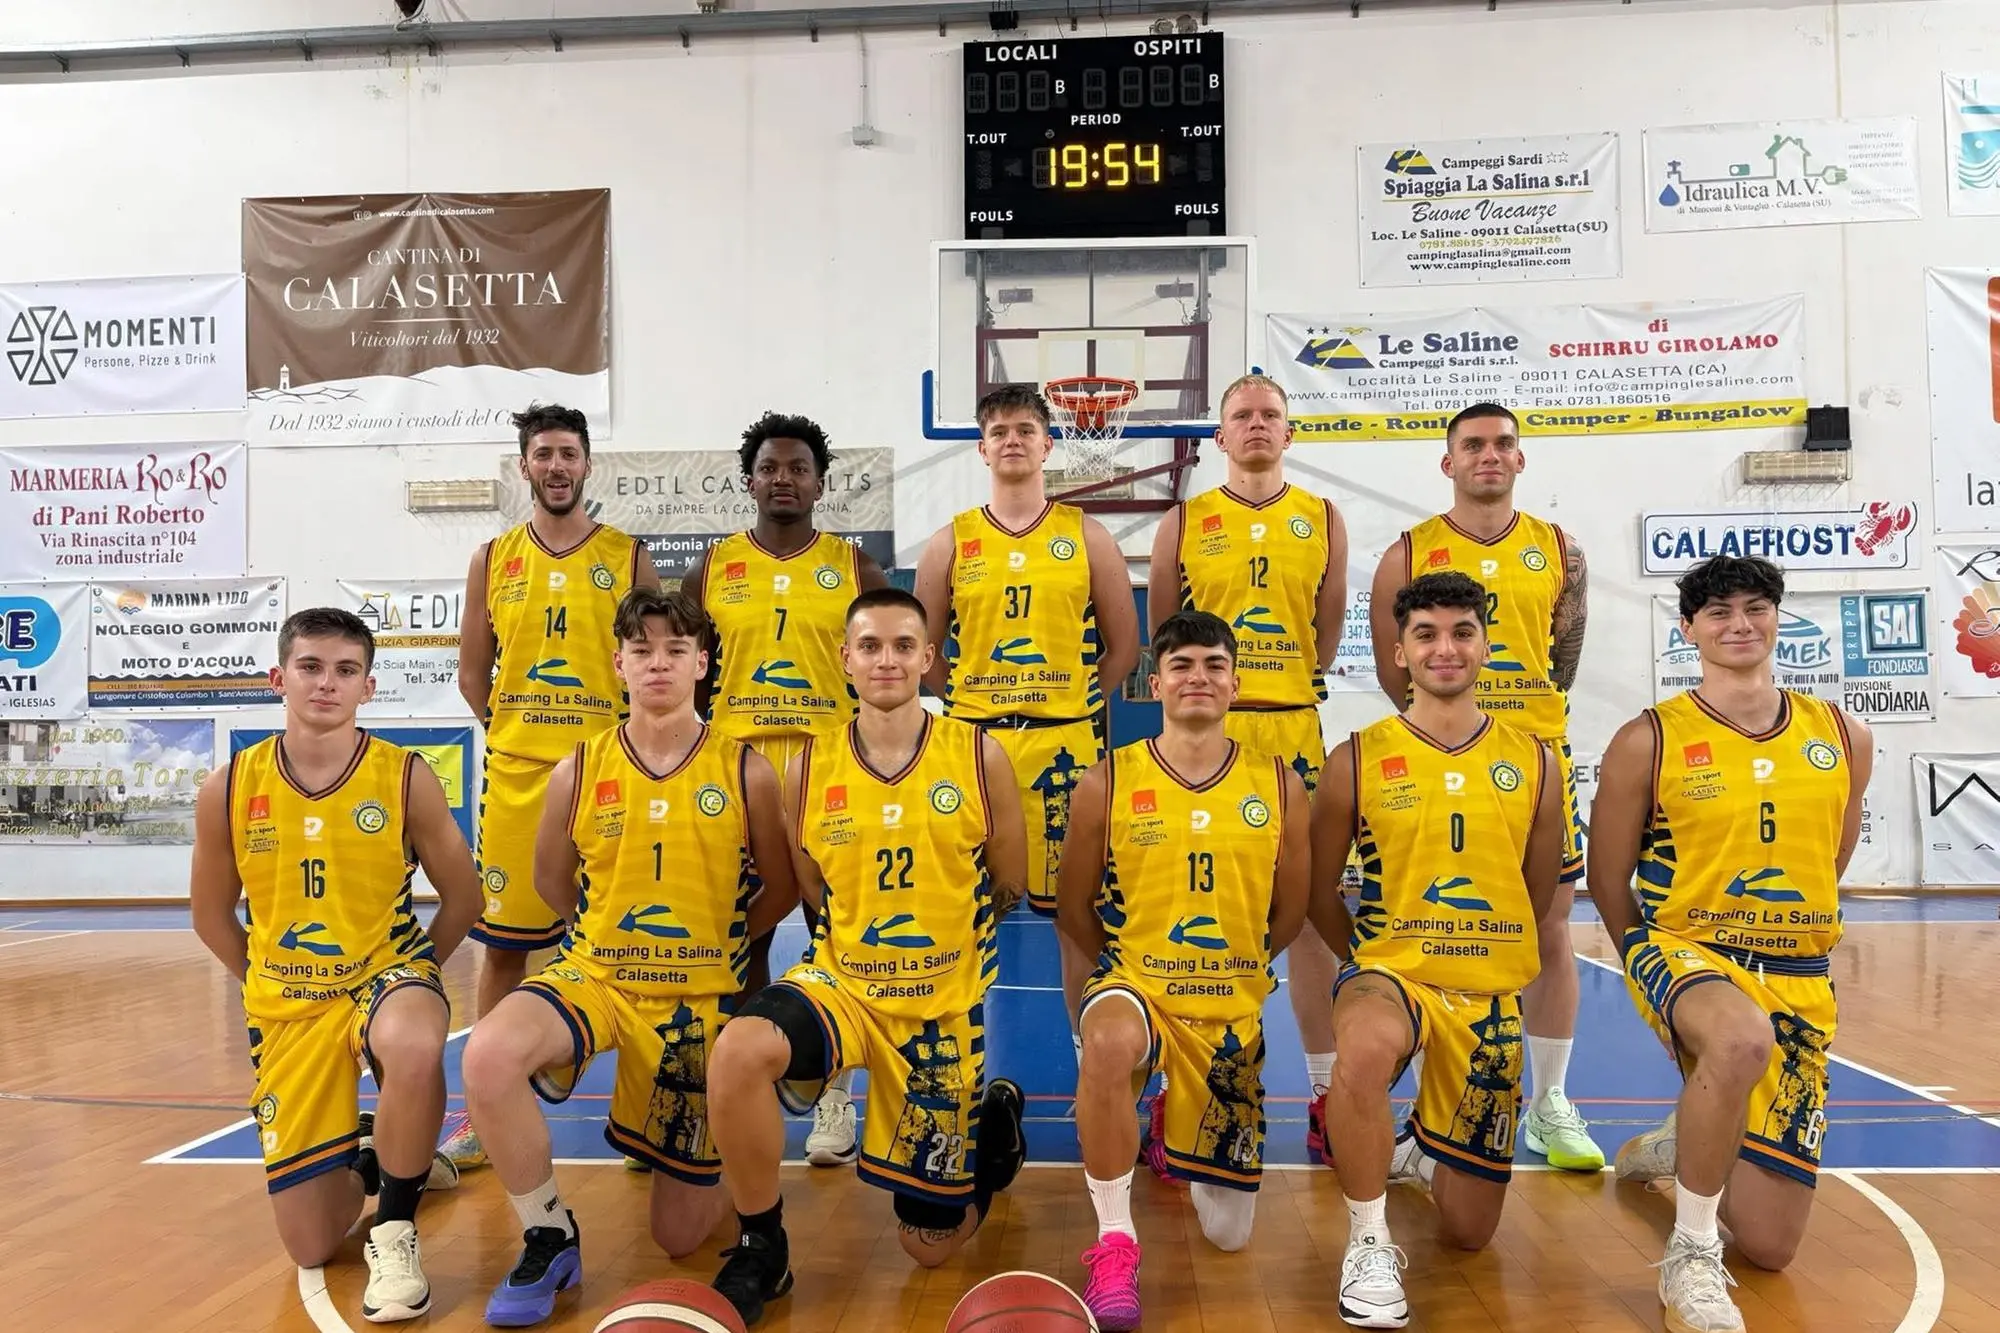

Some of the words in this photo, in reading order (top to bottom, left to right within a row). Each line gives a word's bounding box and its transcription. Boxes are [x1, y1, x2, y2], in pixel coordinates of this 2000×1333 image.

[986, 44, 1057, 62] LOCALI
[1134, 38, 1202, 56] OSPITI
[1055, 80, 1066, 94] B
[1209, 74, 1220, 88] B
[1070, 114, 1121, 126] PERIOD
[967, 134, 1007, 144] T.OUT
[1180, 126, 1222, 137] T.OUT
[1049, 143, 1160, 187] 19:54
[1442, 156, 1504, 170] Campeggi
[1508, 154, 1543, 166] Sardi
[1384, 178, 1462, 198] Spiaggia
[1466, 176, 1488, 192] La
[1492, 173, 1550, 191] Salina
[1685, 181, 1770, 202] Idraulica
[1776, 178, 1823, 197] M.V.
[970, 210, 1014, 222] FOULS
[1174, 204, 1220, 216] FOULS
[1412, 201, 1471, 223] Buone
[1474, 199, 1556, 224] Vacanze
[1372, 230, 1398, 242] Loc.
[1402, 230, 1417, 240] Le
[1420, 228, 1462, 240] Saline
[1471, 227, 1510, 238] 09011
[367, 248, 454, 266] CANTINA
[458, 247, 480, 264] DI
[283, 272, 568, 312] CALASETTA
[84, 316, 216, 348] MOMENTI
[1648, 319, 1669, 332] di
[350, 329, 430, 348] Viticoltori
[432, 328, 459, 346] dal
[466, 328, 500, 346] 1932
[1378, 334, 1413, 355] Le
[1423, 332, 1520, 354] Saline
[1548, 340, 1650, 358] SCHIRRU
[1657, 334, 1779, 354] GIROLAMO
[138, 354, 170, 367] Pizze
[174, 356, 181, 366] &
[185, 353, 217, 365] Drink
[1378, 358, 1444, 370] Campeggi
[1448, 356, 1486, 367] Sardi
[1489, 355, 1519, 366] s.r.l.
[1348, 372, 1416, 387] Località
[1424, 372, 1442, 384] Le
[1449, 370, 1502, 384] Saline
[1521, 370, 1568, 382] 09011
[1576, 365, 1682, 380] CALASETTA
[1689, 363, 1727, 377] (CA)
[1515, 382, 1568, 396] E-mail:
[1574, 374, 1794, 394] info@campinglesaline.com
[1402, 400, 1430, 411] Tel.
[1536, 397, 1562, 407] Fax
[269, 414, 302, 431] Dal
[308, 413, 343, 430] 1932
[346, 413, 392, 430] siamo
[407, 410, 462, 428] custodi
[466, 408, 492, 428] del
[1526, 412, 1631, 428] Camper
[1655, 404, 1795, 423] Bungalow
[10, 467, 129, 492] MARMERIA
[617, 476, 684, 496] EDIL
[32, 506, 52, 526] di
[61, 505, 108, 526] Pani
[116, 504, 205, 525] Roberto
[636, 505, 652, 516] DA
[713, 504, 728, 514] LA
[40, 532, 66, 548] Via
[72, 531, 146, 548] Rinascita
[1652, 524, 1856, 560] CALAFROST
[56, 552, 92, 566] zona
[98, 549, 184, 565] industriale
[1248, 556, 1269, 589] 12
[151, 590, 211, 608] MARINA
[217, 590, 250, 606] LIDO
[1004, 584, 1032, 619] 37
[95, 622, 184, 636] NOLEGGIO
[190, 621, 278, 634] GOMMONI
[545, 606, 568, 640] 14
[775, 608, 788, 641] 7
[1844, 600, 1858, 660] GRUPPO
[1872, 603, 1918, 645] SAI
[182, 641, 190, 650] E
[1257, 640, 1272, 650] La
[122, 658, 172, 670] MOTO
[178, 655, 256, 668] D'ACQUA
[408, 658, 435, 670] Main
[1868, 659, 1925, 674] FONDIARIA
[404, 672, 426, 684] Tel.
[964, 672, 1018, 686] Camping
[1020, 670, 1035, 682] La
[1496, 678, 1511, 689] La
[1818, 673, 1840, 684] AUTO
[1844, 680, 1893, 692] DIVISIONE
[10, 698, 56, 708] IGLESIAS
[138, 691, 175, 700] Cristoforo
[499, 692, 551, 706] Camping
[555, 692, 570, 704] La
[574, 693, 614, 710] Salina
[728, 694, 780, 708] Camping
[783, 694, 798, 706] La
[801, 694, 836, 708] Salina
[990, 692, 1048, 705] Calasetta
[1844, 690, 1930, 712] FONDIARIA
[522, 712, 584, 725] Calasetta
[753, 714, 811, 726] Calasetta
[1688, 756, 1710, 766] LCA
[1760, 801, 1776, 844] 6
[1450, 812, 1465, 853] 0
[652, 842, 663, 881] 1
[876, 846, 914, 892] 22
[300, 858, 326, 900] 16
[1188, 852, 1214, 893] 13
[1688, 908, 1757, 924] Camping
[1762, 910, 1784, 924] La
[1789, 910, 1834, 925] Salina
[1391, 917, 1455, 934] Camping
[1458, 918, 1474, 932] La
[1478, 918, 1524, 934] Salina
[1714, 929, 1798, 949] Calasetta
[654, 945, 673, 958] La
[677, 946, 722, 960] Salina
[1422, 942, 1490, 957] Calasetta
[902, 956, 918, 972] La
[923, 948, 962, 969] Salina
[1142, 954, 1196, 972] Camping
[1201, 958, 1220, 972] La
[316, 964, 328, 976] La
[616, 968, 688, 984] Calasetta
[282, 986, 351, 1002] Calasetta
[866, 982, 934, 999] Calasetta
[1166, 982, 1234, 997] Calasetta
[1493, 1112, 1510, 1150] 0
[1804, 1110, 1825, 1150] 6
[926, 1132, 964, 1175] 22
